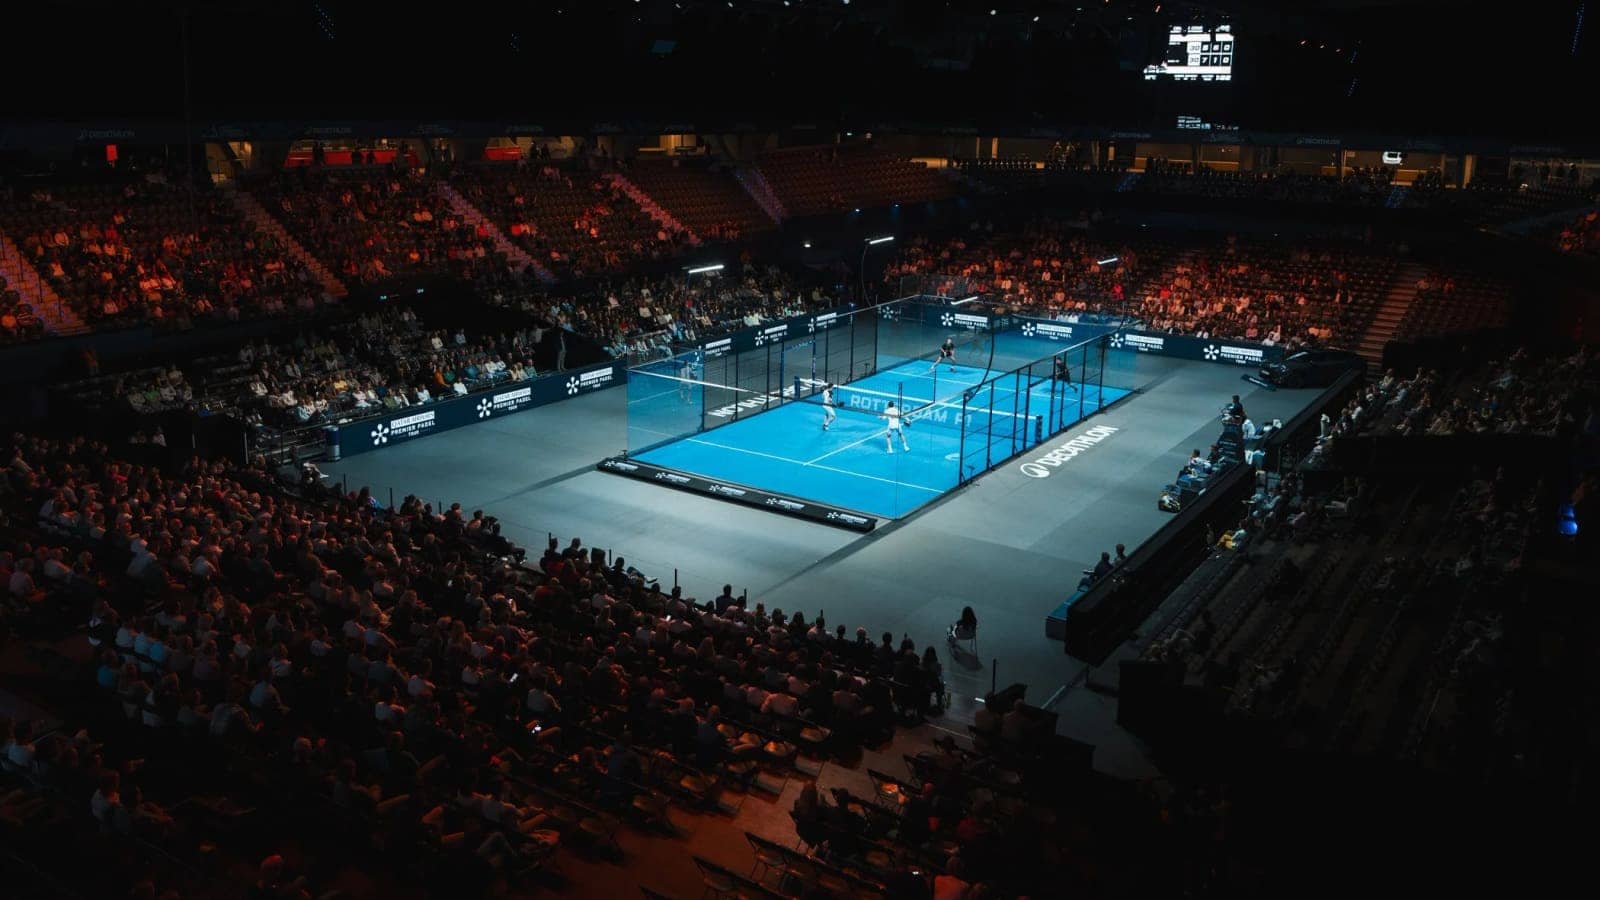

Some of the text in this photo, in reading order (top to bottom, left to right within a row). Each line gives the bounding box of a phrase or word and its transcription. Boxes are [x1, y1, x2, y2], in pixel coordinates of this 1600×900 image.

[391, 420, 436, 436] PREMIER PADEL
[1035, 425, 1120, 467] DECATHLON
